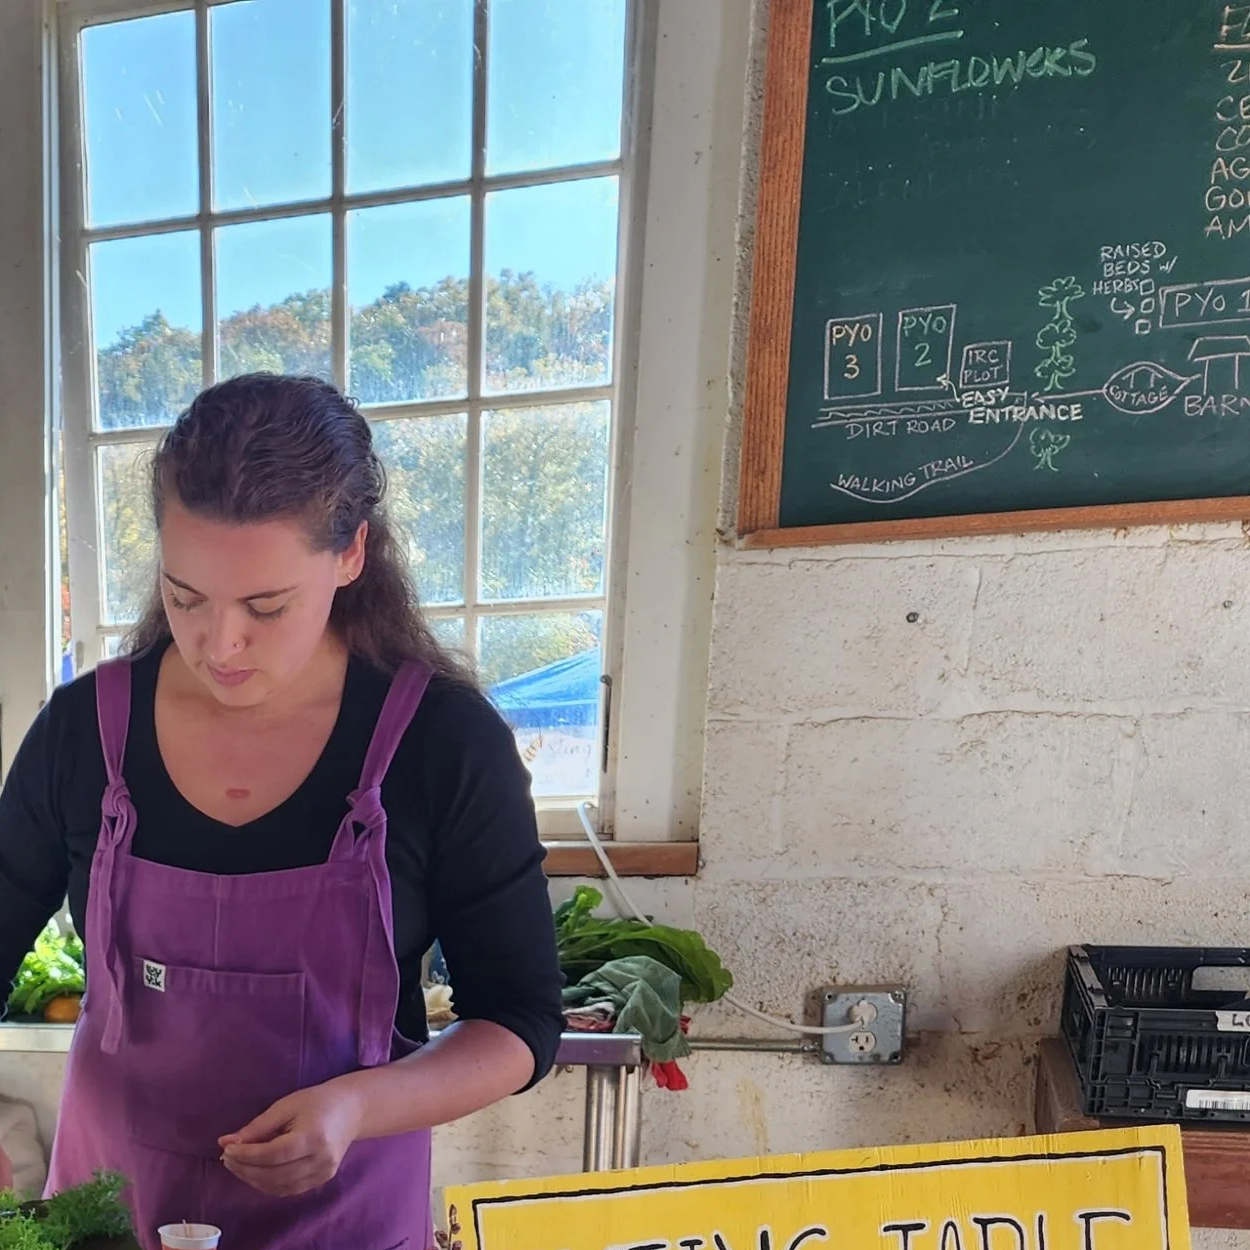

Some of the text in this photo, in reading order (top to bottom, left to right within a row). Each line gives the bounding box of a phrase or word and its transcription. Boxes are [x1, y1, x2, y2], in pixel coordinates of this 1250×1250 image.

[1100, 241, 1167, 262] RAISED
[1103, 260, 1150, 278] BEDS
[1175, 287, 1226, 318] PYO
[831, 323, 872, 347] PYO
[902, 312, 948, 337] PYO
[913, 342, 932, 367] 2
[968, 349, 1000, 365] IRC
[843, 354, 861, 380] 3
[963, 365, 1004, 384] PLOT
[961, 386, 1010, 408] EASY
[1109, 385, 1169, 406] COTTAGE
[968, 403, 1084, 424] ENTRANCE
[846, 417, 956, 440] DIRT ROAD
[837, 455, 974, 493] WALKING TRAIL
